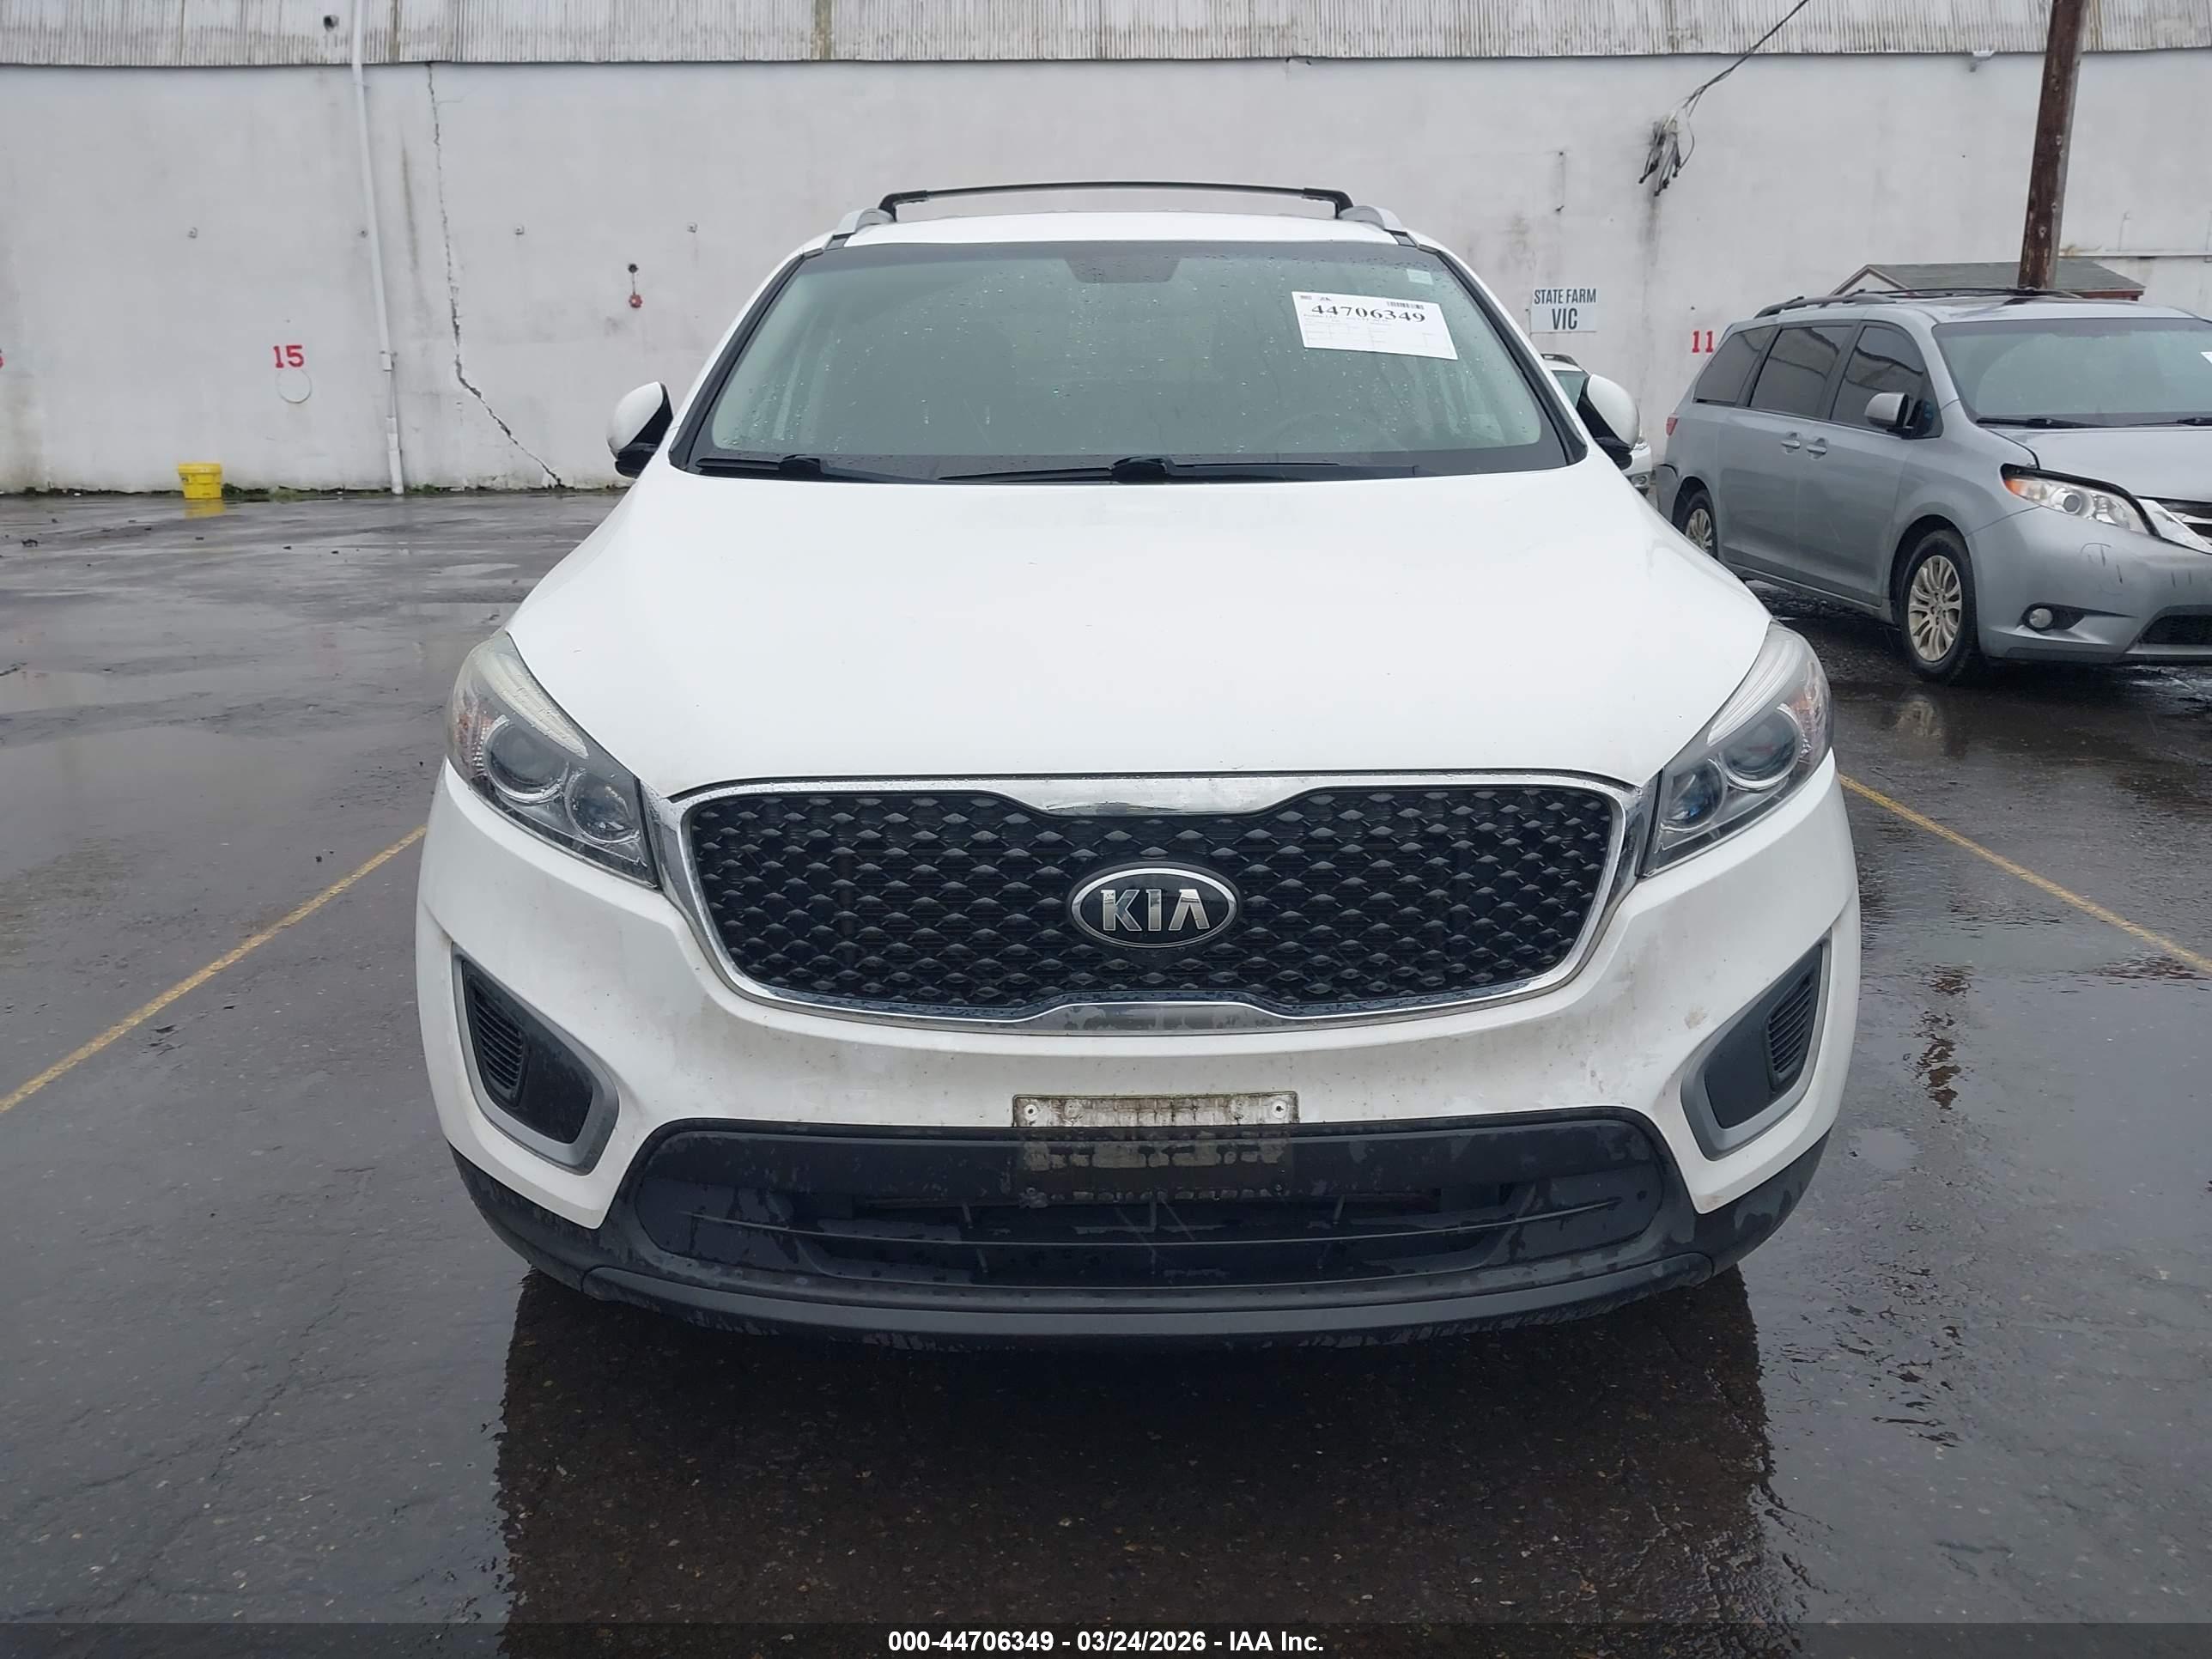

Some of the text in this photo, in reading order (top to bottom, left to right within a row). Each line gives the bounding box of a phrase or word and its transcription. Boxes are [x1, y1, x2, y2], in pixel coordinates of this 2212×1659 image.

[1534, 288, 1596, 305] STATE FARM
[1311, 304, 1425, 322] 44706349
[1552, 307, 1577, 331] VIC
[1692, 330, 1714, 354] 11
[273, 343, 305, 368] 15
[1100, 889, 1210, 932] KIA
